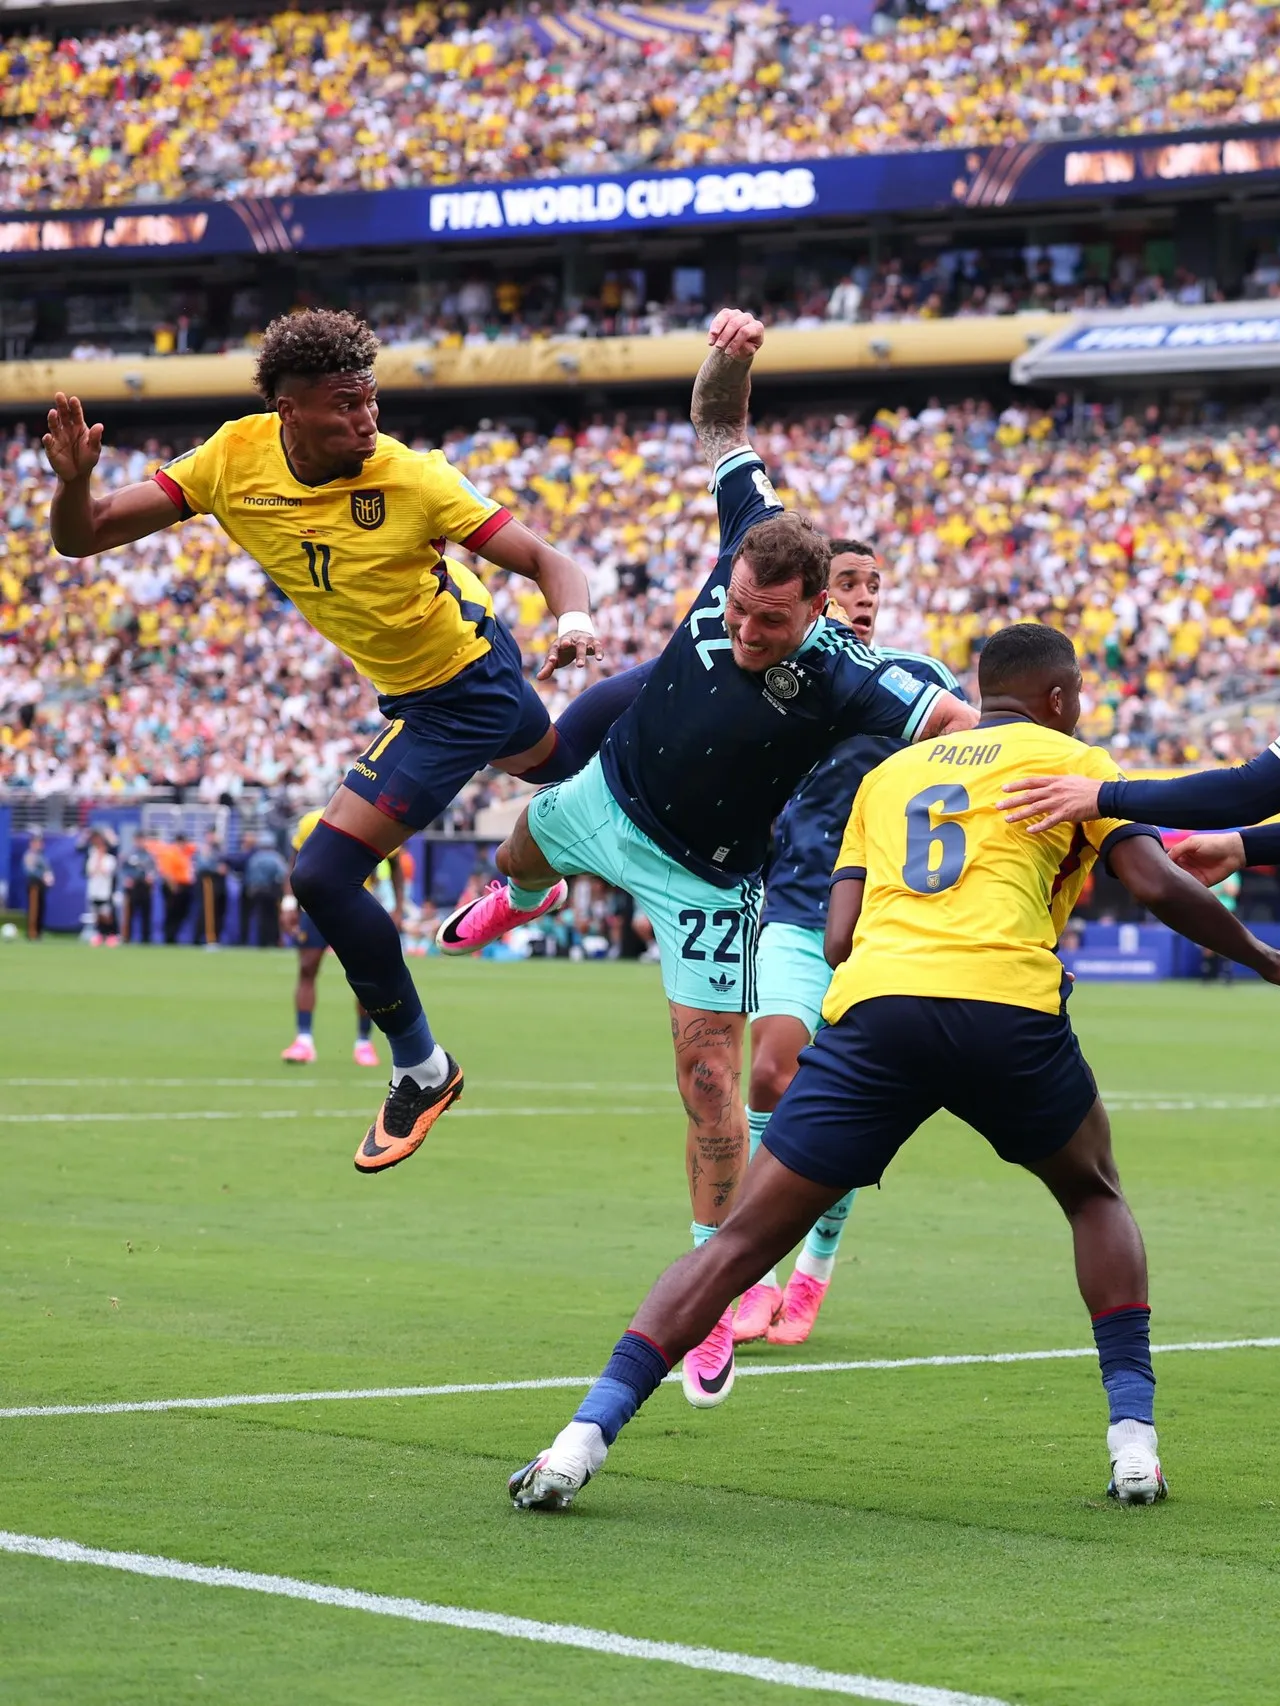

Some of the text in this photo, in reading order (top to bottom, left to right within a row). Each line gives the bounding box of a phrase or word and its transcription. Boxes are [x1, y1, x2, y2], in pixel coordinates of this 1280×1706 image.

[429, 168, 815, 231] FIFA WORLD CUP 2026
[243, 495, 302, 507] marathon
[301, 541, 333, 591] 11
[928, 743, 1002, 766] PACHO
[902, 784, 970, 894] 6
[678, 909, 740, 963] 22
